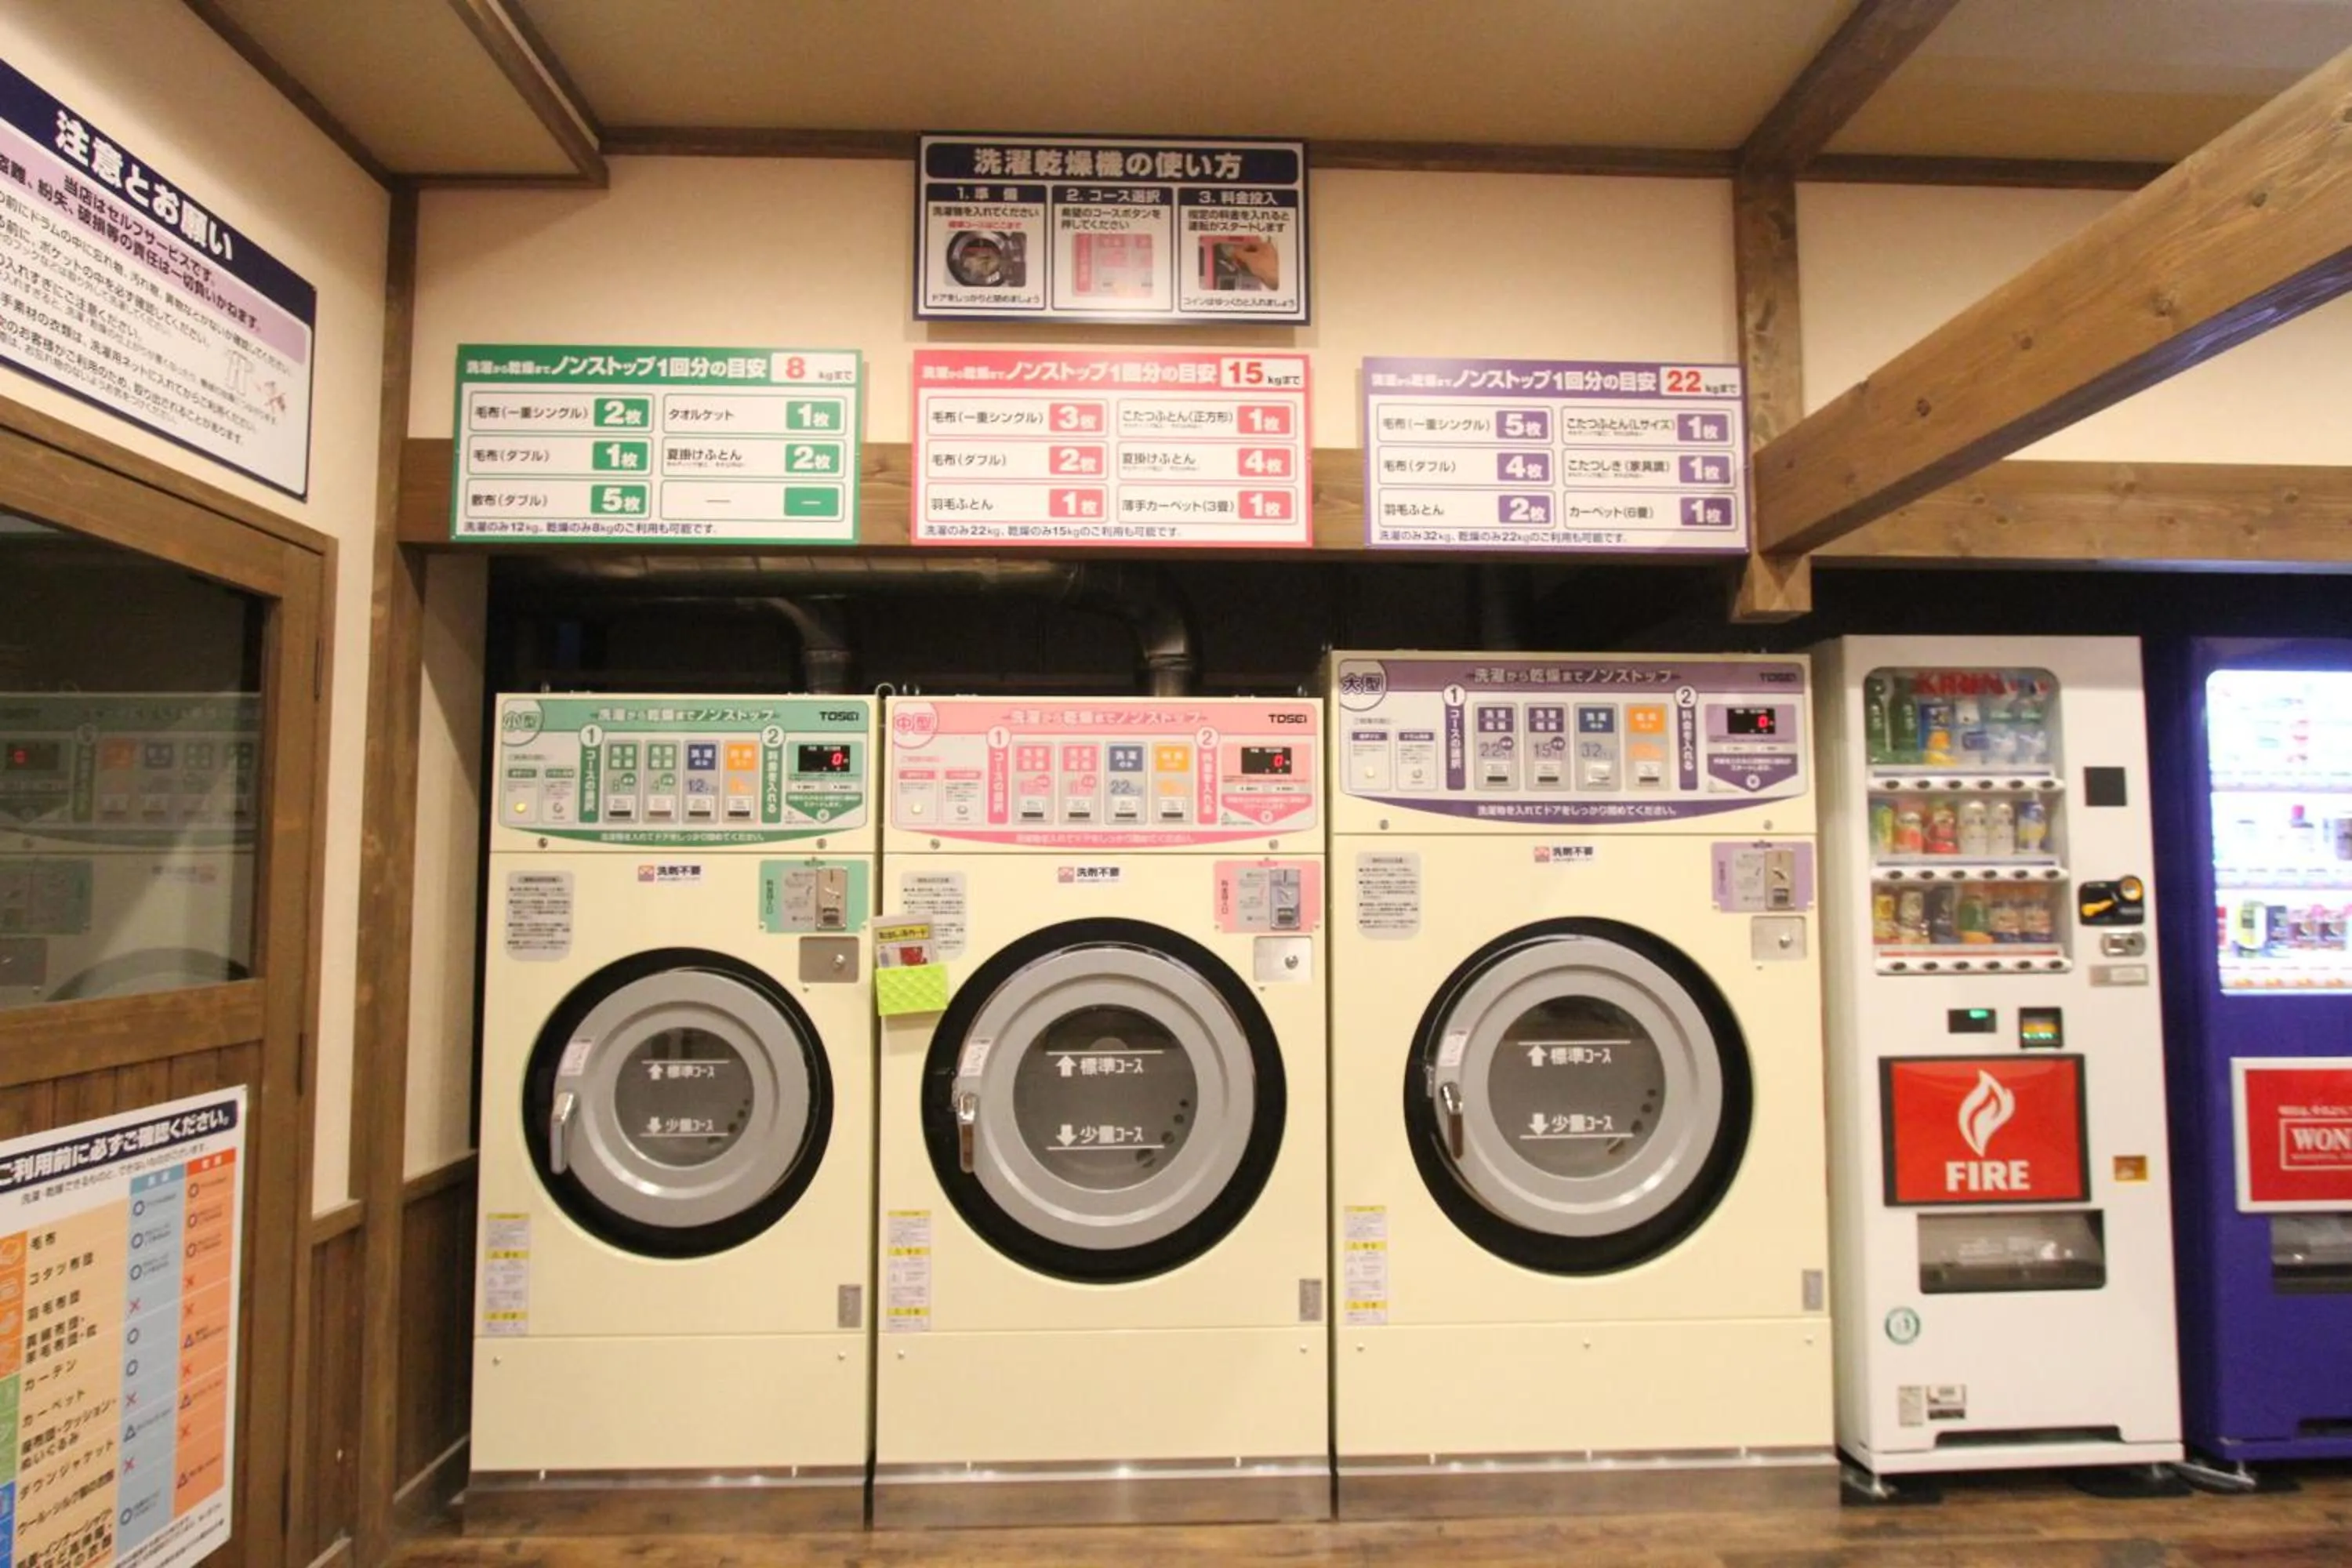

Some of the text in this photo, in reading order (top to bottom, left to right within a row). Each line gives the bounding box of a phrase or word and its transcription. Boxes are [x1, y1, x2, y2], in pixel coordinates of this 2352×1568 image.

[974, 148, 1243, 180] 洗濯乾燥機の使い方
[56, 107, 233, 267] 注意とお願い
[786, 357, 805, 379] 8
[1228, 361, 1263, 383] 15
[1666, 370, 1701, 392] 22
[604, 401, 642, 426] 2枚
[668, 404, 829, 428] タオルケット 1枚
[1058, 405, 1096, 430] 3枚
[1249, 408, 1279, 432] 1枚
[1504, 413, 1541, 437] 5枚
[1688, 416, 1719, 439] 1枚
[606, 446, 638, 469] 1枚
[792, 447, 831, 470] 2枚
[1060, 449, 1096, 472] 2枚
[1244, 450, 1283, 475] 4枚
[1505, 456, 1543, 478] 4枚
[1690, 457, 1720, 481] 1枚
[601, 488, 640, 512] 5枚
[931, 492, 1097, 516] 羽毛ふとん 1枚
[1250, 493, 1281, 517] 1枚
[1384, 498, 1546, 521] 羽毛ふとん 2枚
[1691, 499, 1722, 523] 1枚
[1342, 673, 1384, 695] 大型
[895, 714, 935, 732] 中型
[1268, 714, 1308, 724] TOSEI
[1080, 1058, 1144, 1076] 標準コース
[1550, 1047, 1612, 1065] 標準コース
[2289, 1127, 2352, 1151] WON
[1945, 1160, 2031, 1192] FIRE
[25, 1358, 76, 1392] カーテン
